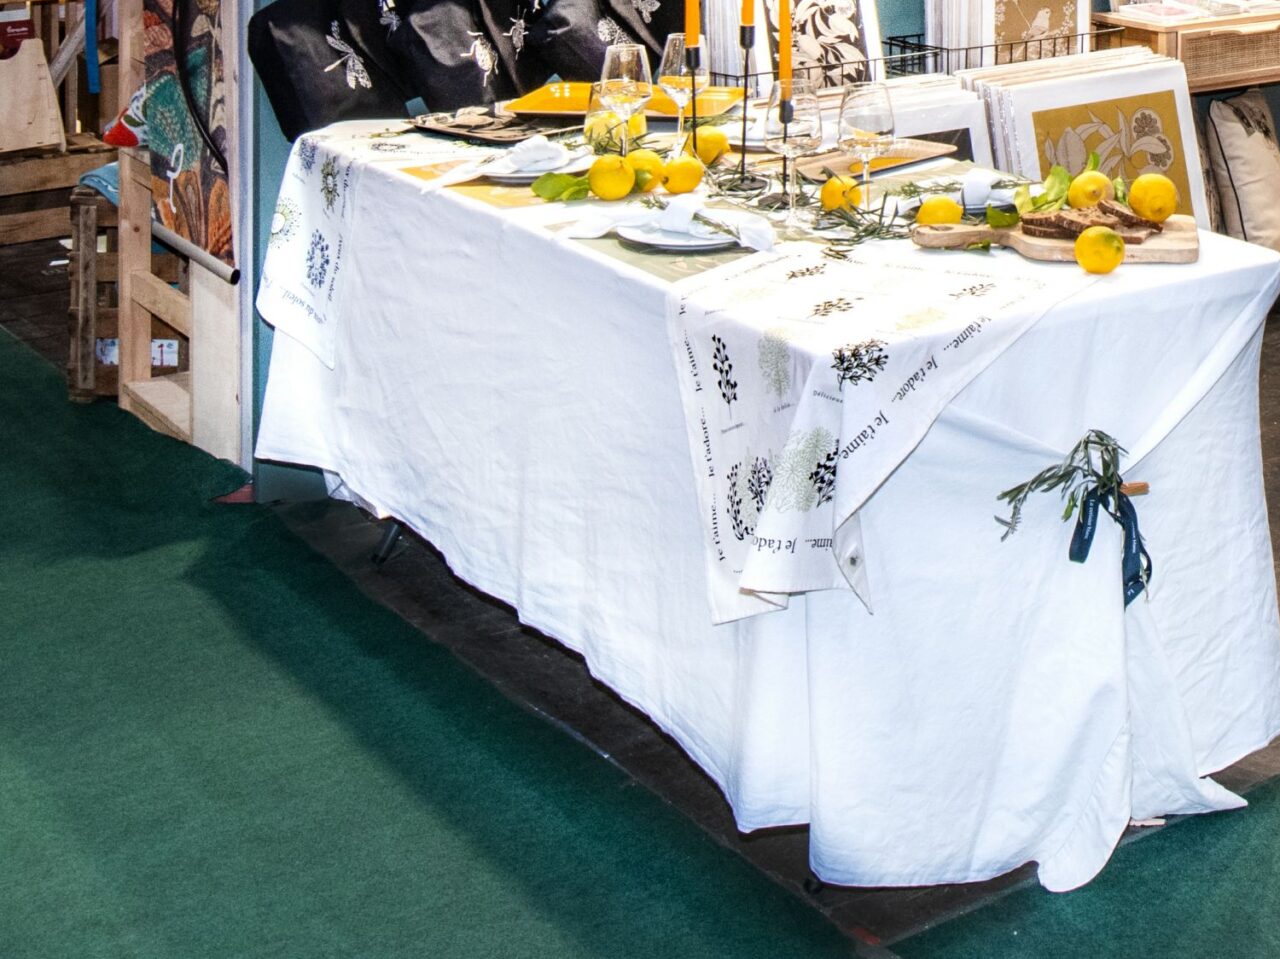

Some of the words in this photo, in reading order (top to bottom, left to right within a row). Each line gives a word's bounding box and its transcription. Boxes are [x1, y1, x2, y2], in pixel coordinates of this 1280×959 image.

[943, 321, 982, 351] t'aime...
[926, 355, 938, 370] Je
[874, 410, 889, 427] Je
[785, 537, 798, 553] Je
